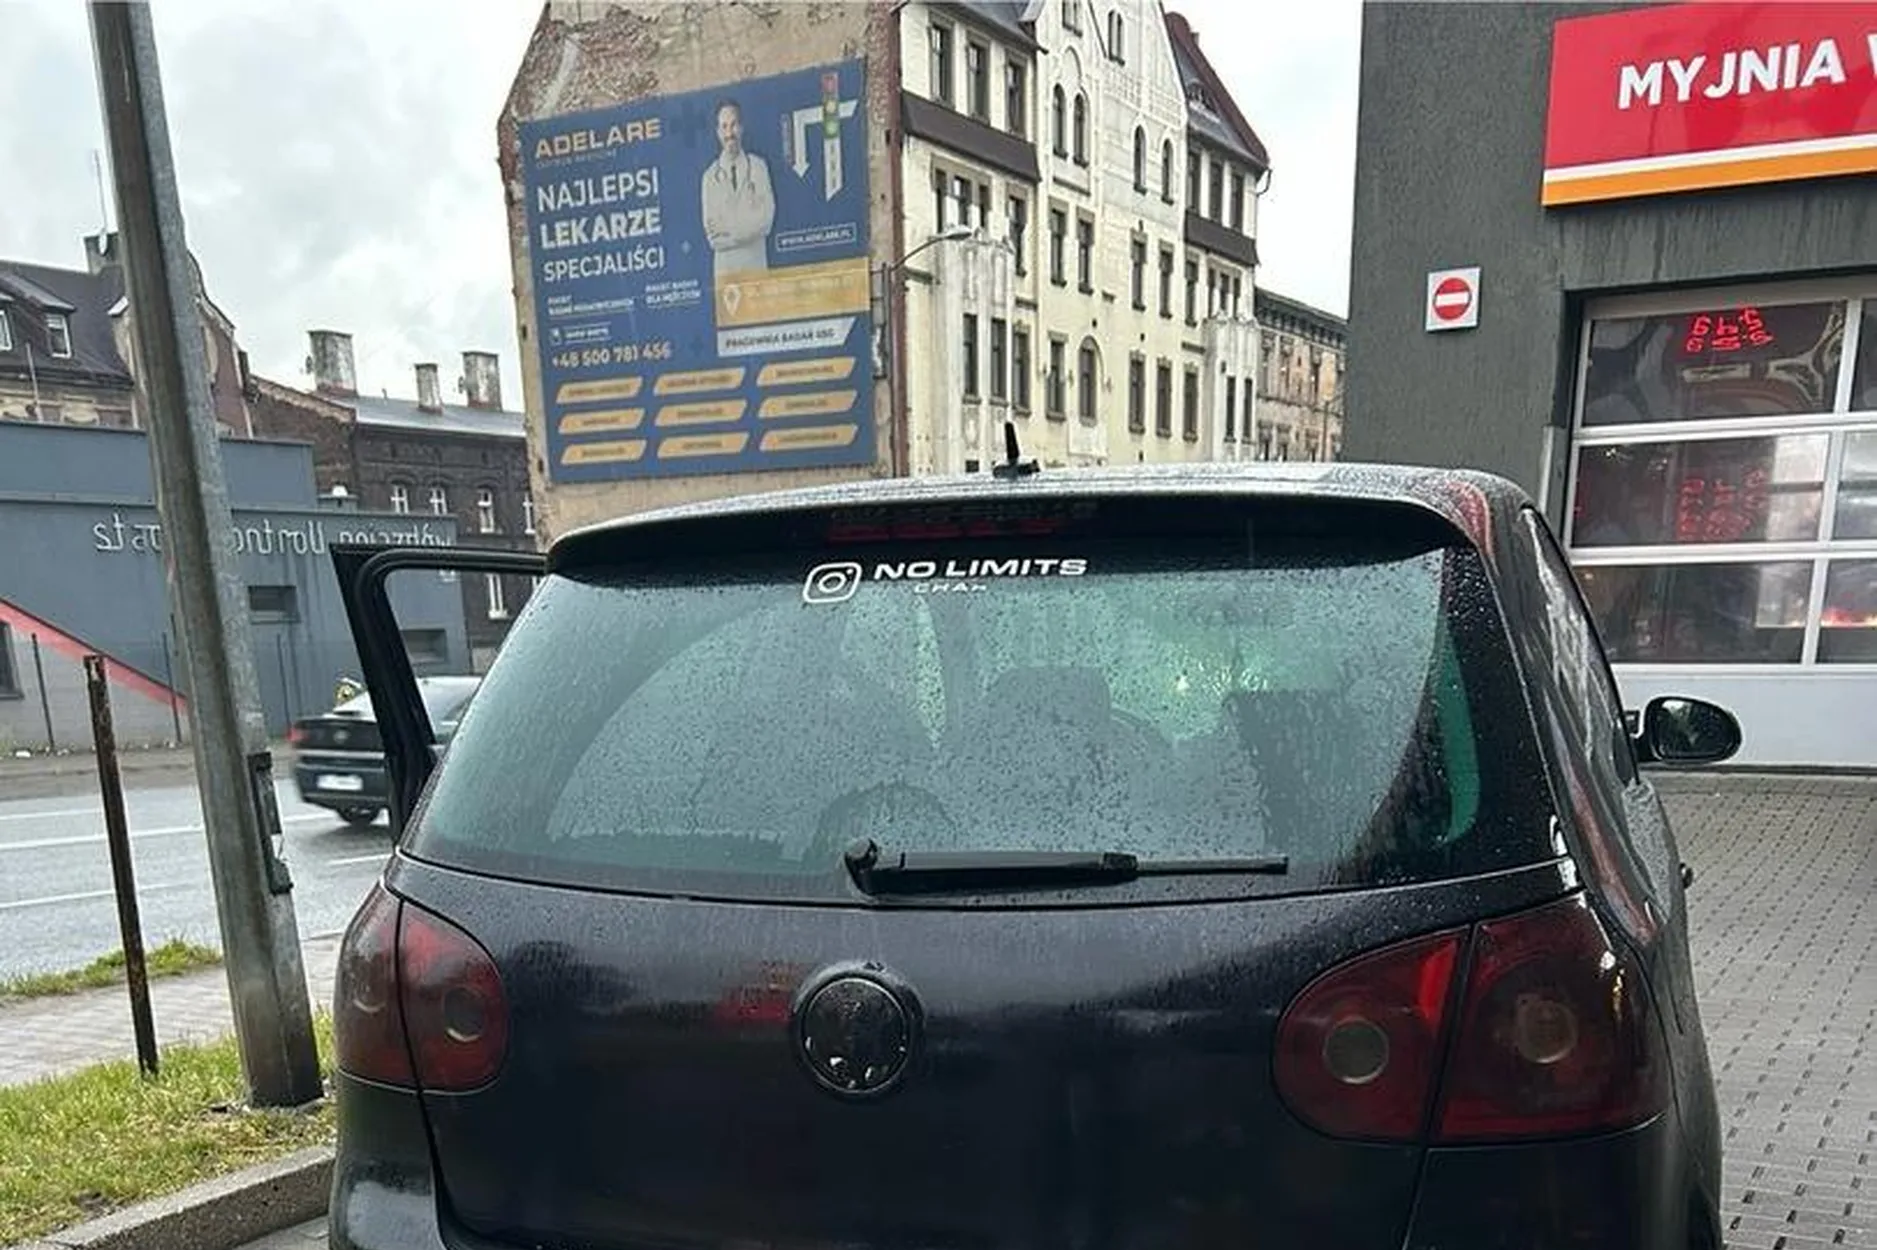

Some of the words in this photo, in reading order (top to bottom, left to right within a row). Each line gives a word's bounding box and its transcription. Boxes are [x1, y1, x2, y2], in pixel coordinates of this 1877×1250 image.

[1618, 38, 1846, 110] MYJNIA
[535, 117, 662, 159] ADELARE
[537, 166, 659, 213] NAJLEPSI
[540, 207, 662, 249] LEKARZE
[543, 244, 665, 283] SPECJALIŚCI
[582, 348, 610, 366] 500
[612, 345, 639, 363] 781
[874, 561, 937, 580] NO
[945, 559, 1088, 577] LIMITS
